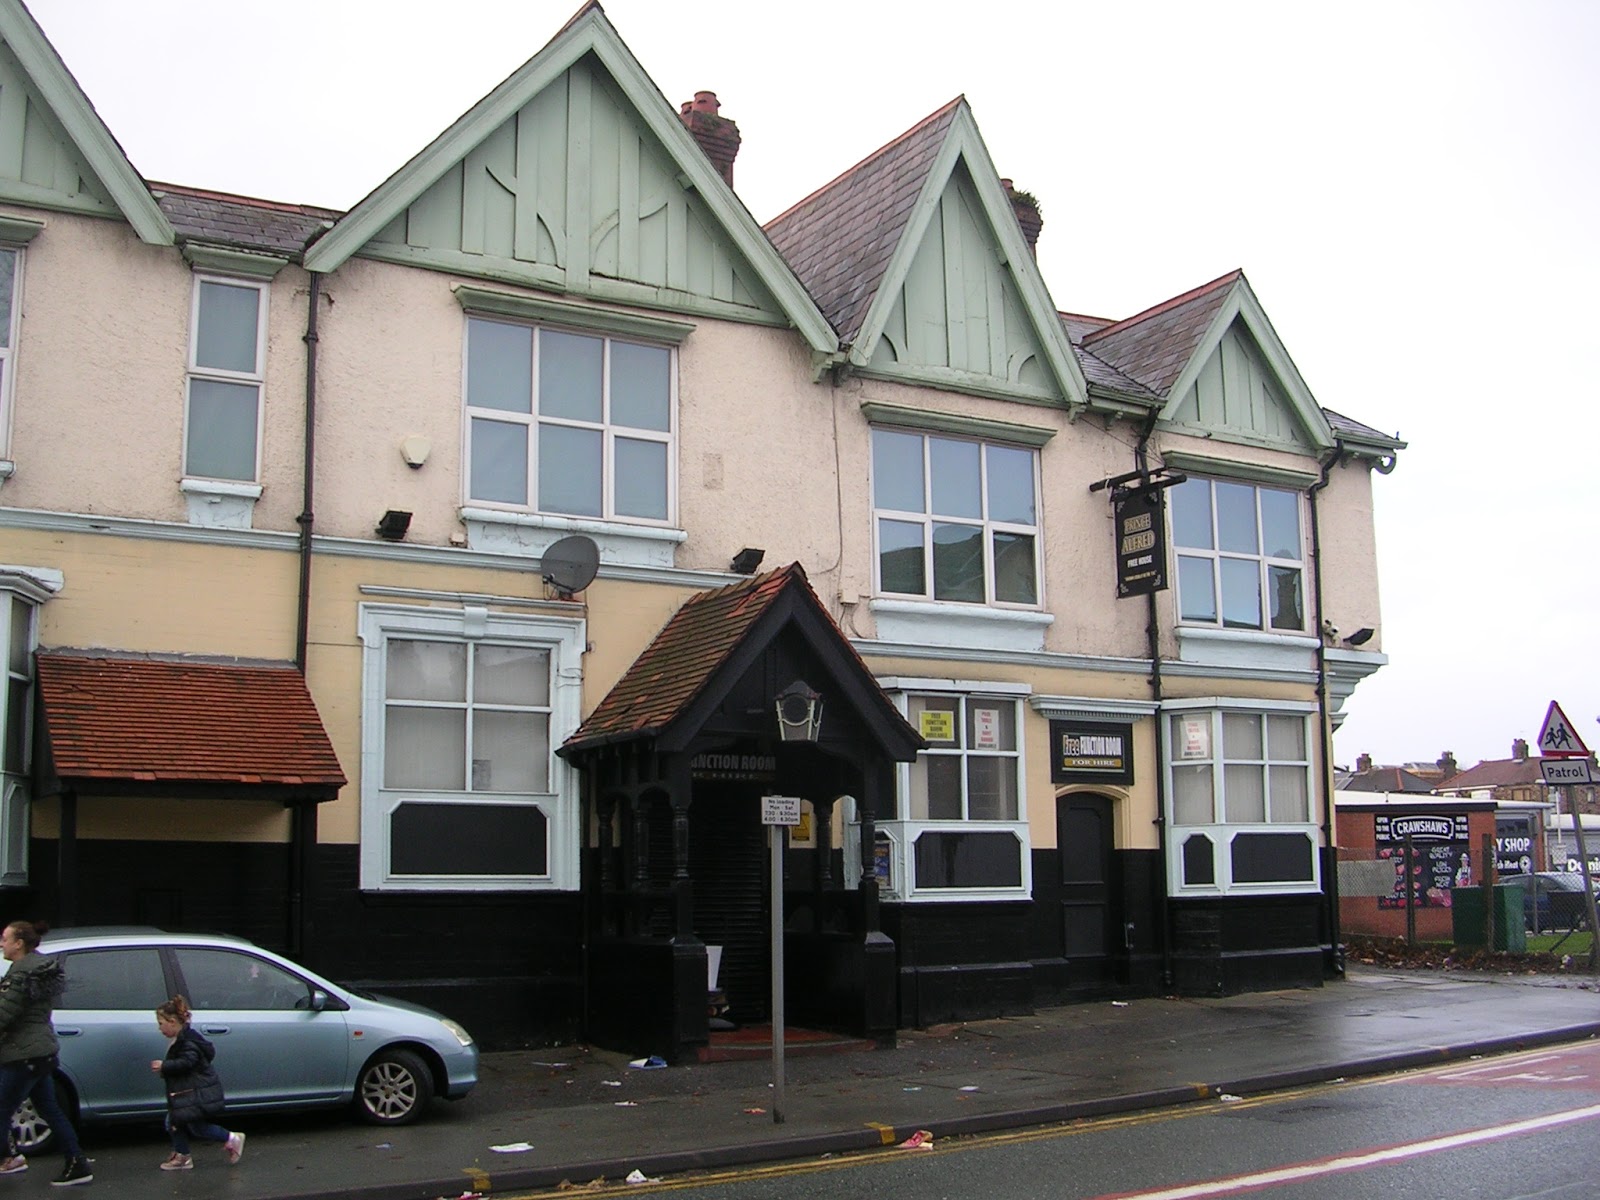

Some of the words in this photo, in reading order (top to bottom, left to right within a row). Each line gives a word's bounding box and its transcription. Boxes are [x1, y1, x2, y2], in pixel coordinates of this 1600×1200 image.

[1124, 514, 1151, 533] PRINCE
[1122, 532, 1155, 553] ALFRED
[1062, 734, 1080, 755] Free
[741, 756, 776, 770] ROOM
[1547, 766, 1584, 778] Patrol
[1397, 821, 1449, 834] CRAWSHAWS
[1504, 837, 1530, 852] SHOP
